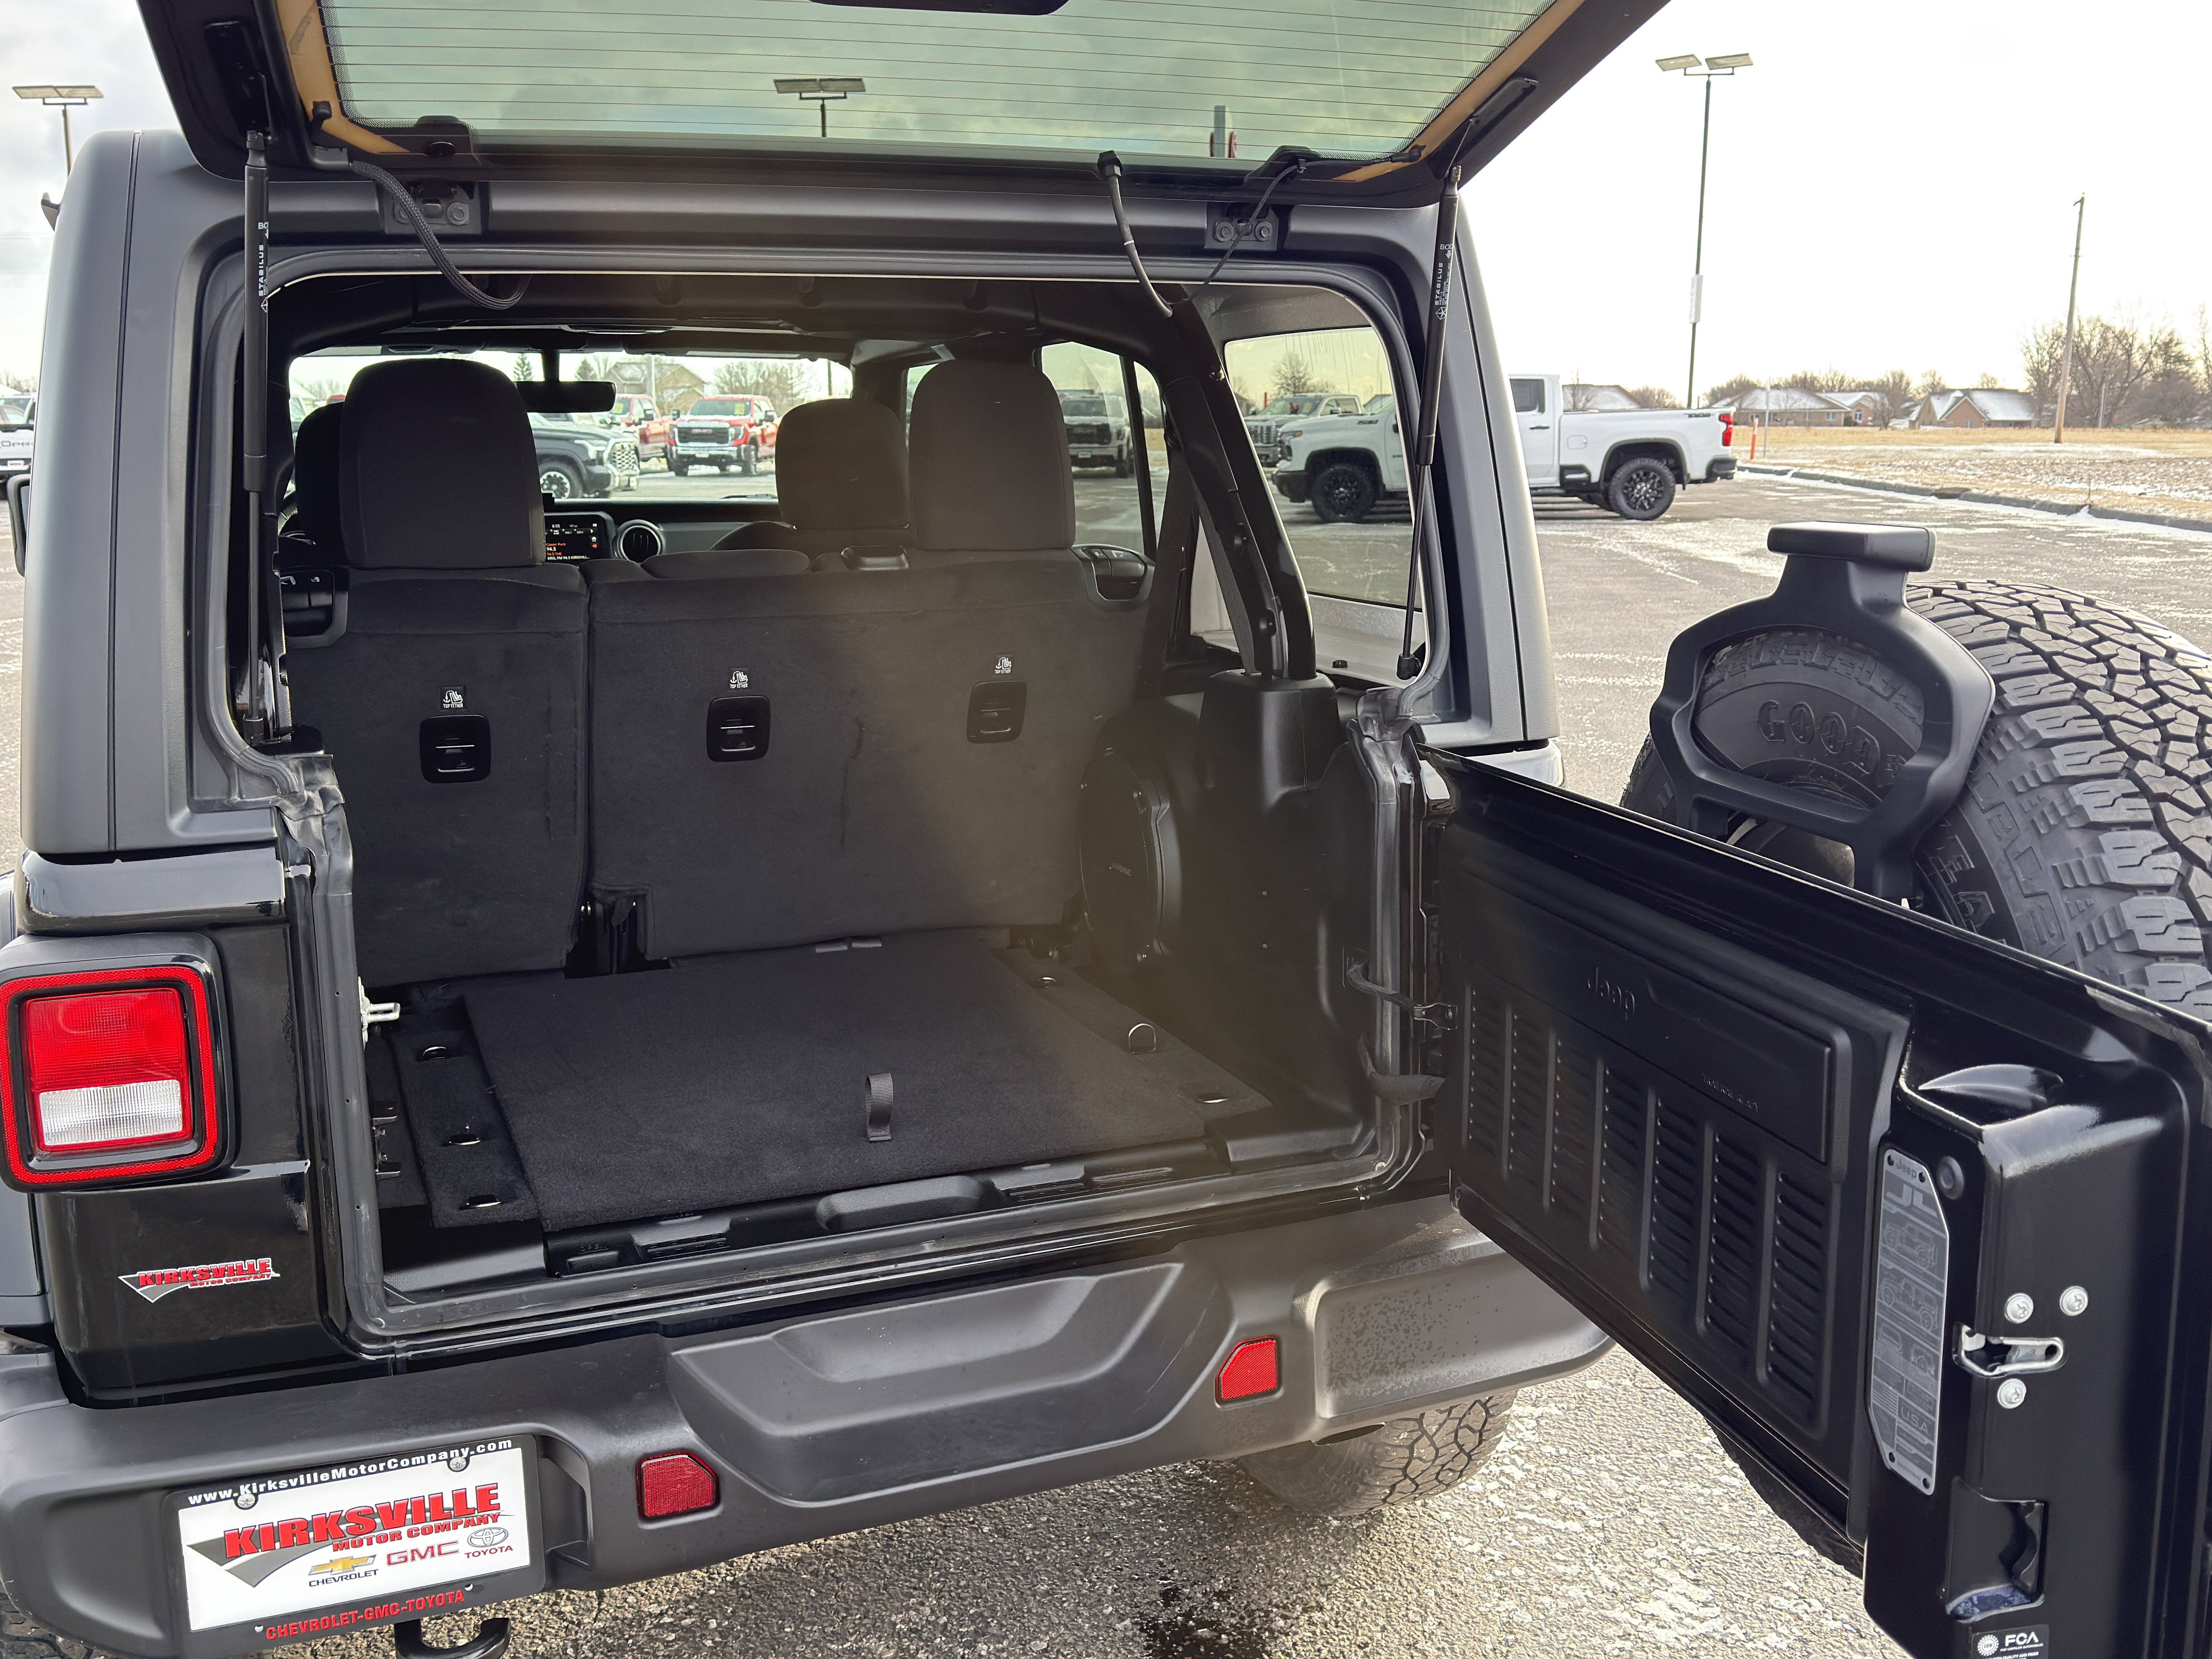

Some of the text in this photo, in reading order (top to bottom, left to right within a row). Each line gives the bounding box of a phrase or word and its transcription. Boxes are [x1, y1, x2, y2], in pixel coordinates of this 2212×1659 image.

[1435, 263, 1443, 305] STABILUS
[1896, 1158, 1917, 1179] Jeep
[138, 1259, 271, 1286] KIRKSVILLE
[225, 1274, 271, 1283] COMPANY
[1901, 1406, 1928, 1433] USA
[188, 1439, 512, 1505] www.KirksvilleMotorCompany.com
[223, 1482, 500, 1558] KIRKSVILLE
[332, 1512, 501, 1552] MOTOR COMPANY
[386, 1539, 460, 1567] GMC
[464, 1545, 514, 1559] TOYOTA
[308, 1568, 379, 1587] CHEVROLET
[266, 1589, 465, 1641] CHEVROLET-GMC-TOYOTA
[2005, 1632, 2039, 1647] FCA
